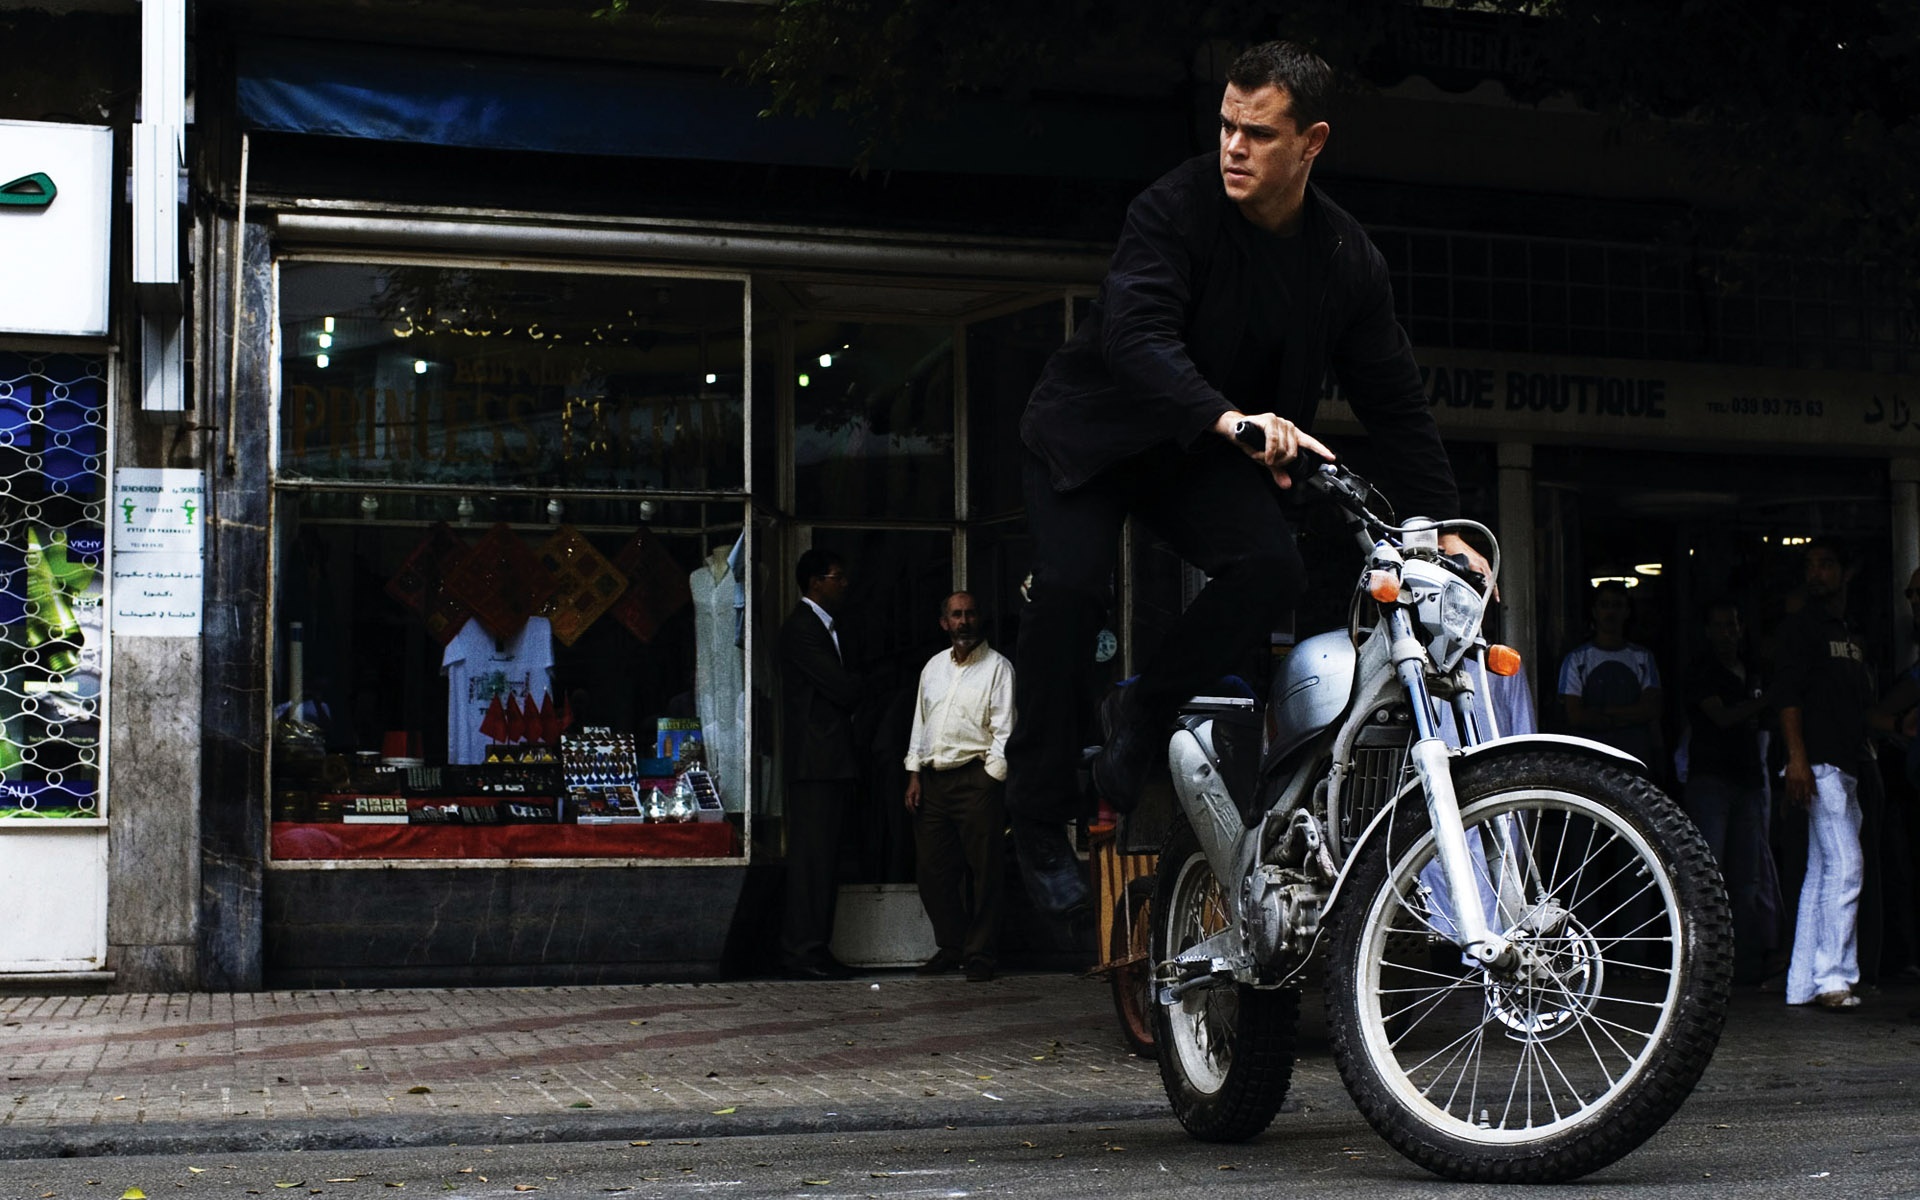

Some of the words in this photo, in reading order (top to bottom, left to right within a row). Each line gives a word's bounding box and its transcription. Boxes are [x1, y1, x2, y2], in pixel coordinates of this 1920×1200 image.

[1506, 371, 1666, 418] BOUTIQUE
[1731, 397, 1758, 414] 039
[1762, 398, 1780, 415] 93
[1785, 399, 1802, 415] 75
[1806, 399, 1824, 416] 63
[292, 383, 538, 464] PRINCESS
[70, 540, 101, 549] VICHY
